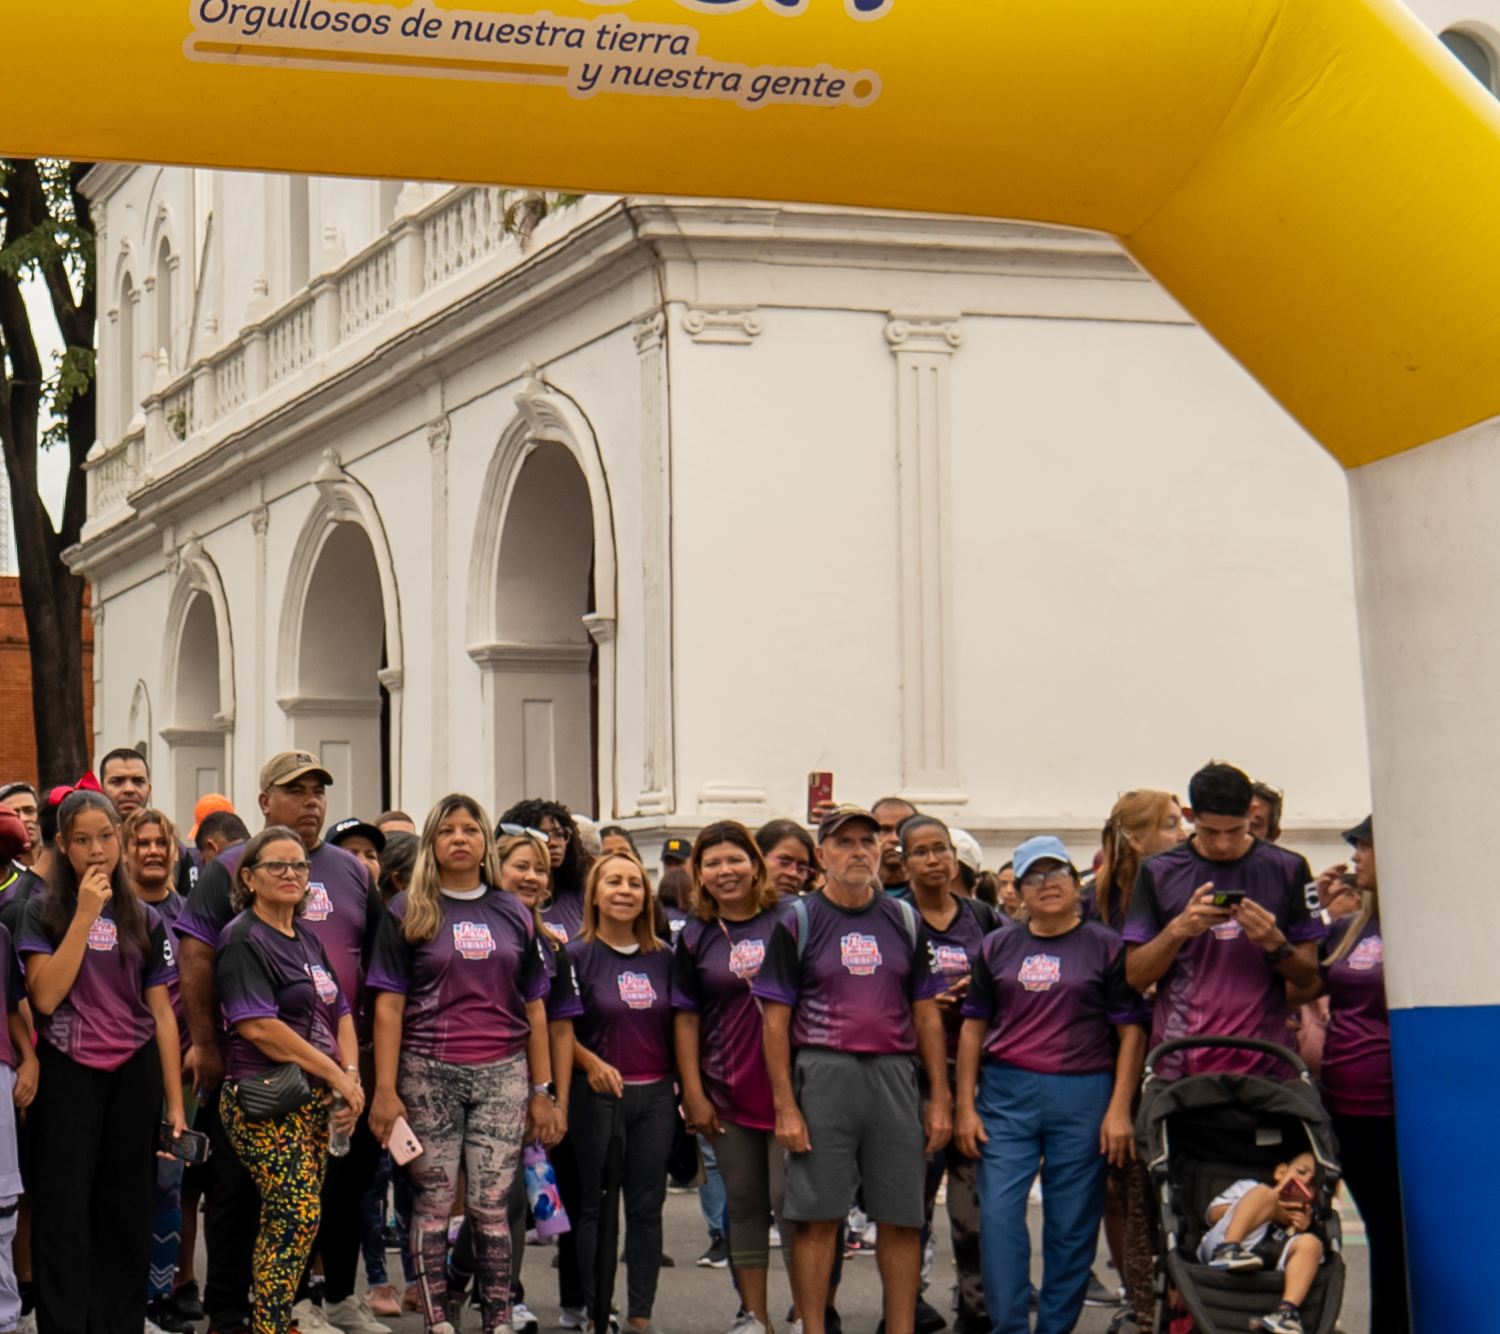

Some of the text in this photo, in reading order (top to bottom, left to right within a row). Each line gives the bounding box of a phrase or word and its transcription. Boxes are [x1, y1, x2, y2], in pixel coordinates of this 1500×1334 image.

[400, 7, 443, 42] de
[452, 19, 585, 50] nuestra
[595, 22, 692, 58] tierra
[577, 63, 847, 104] y nuestra gente
